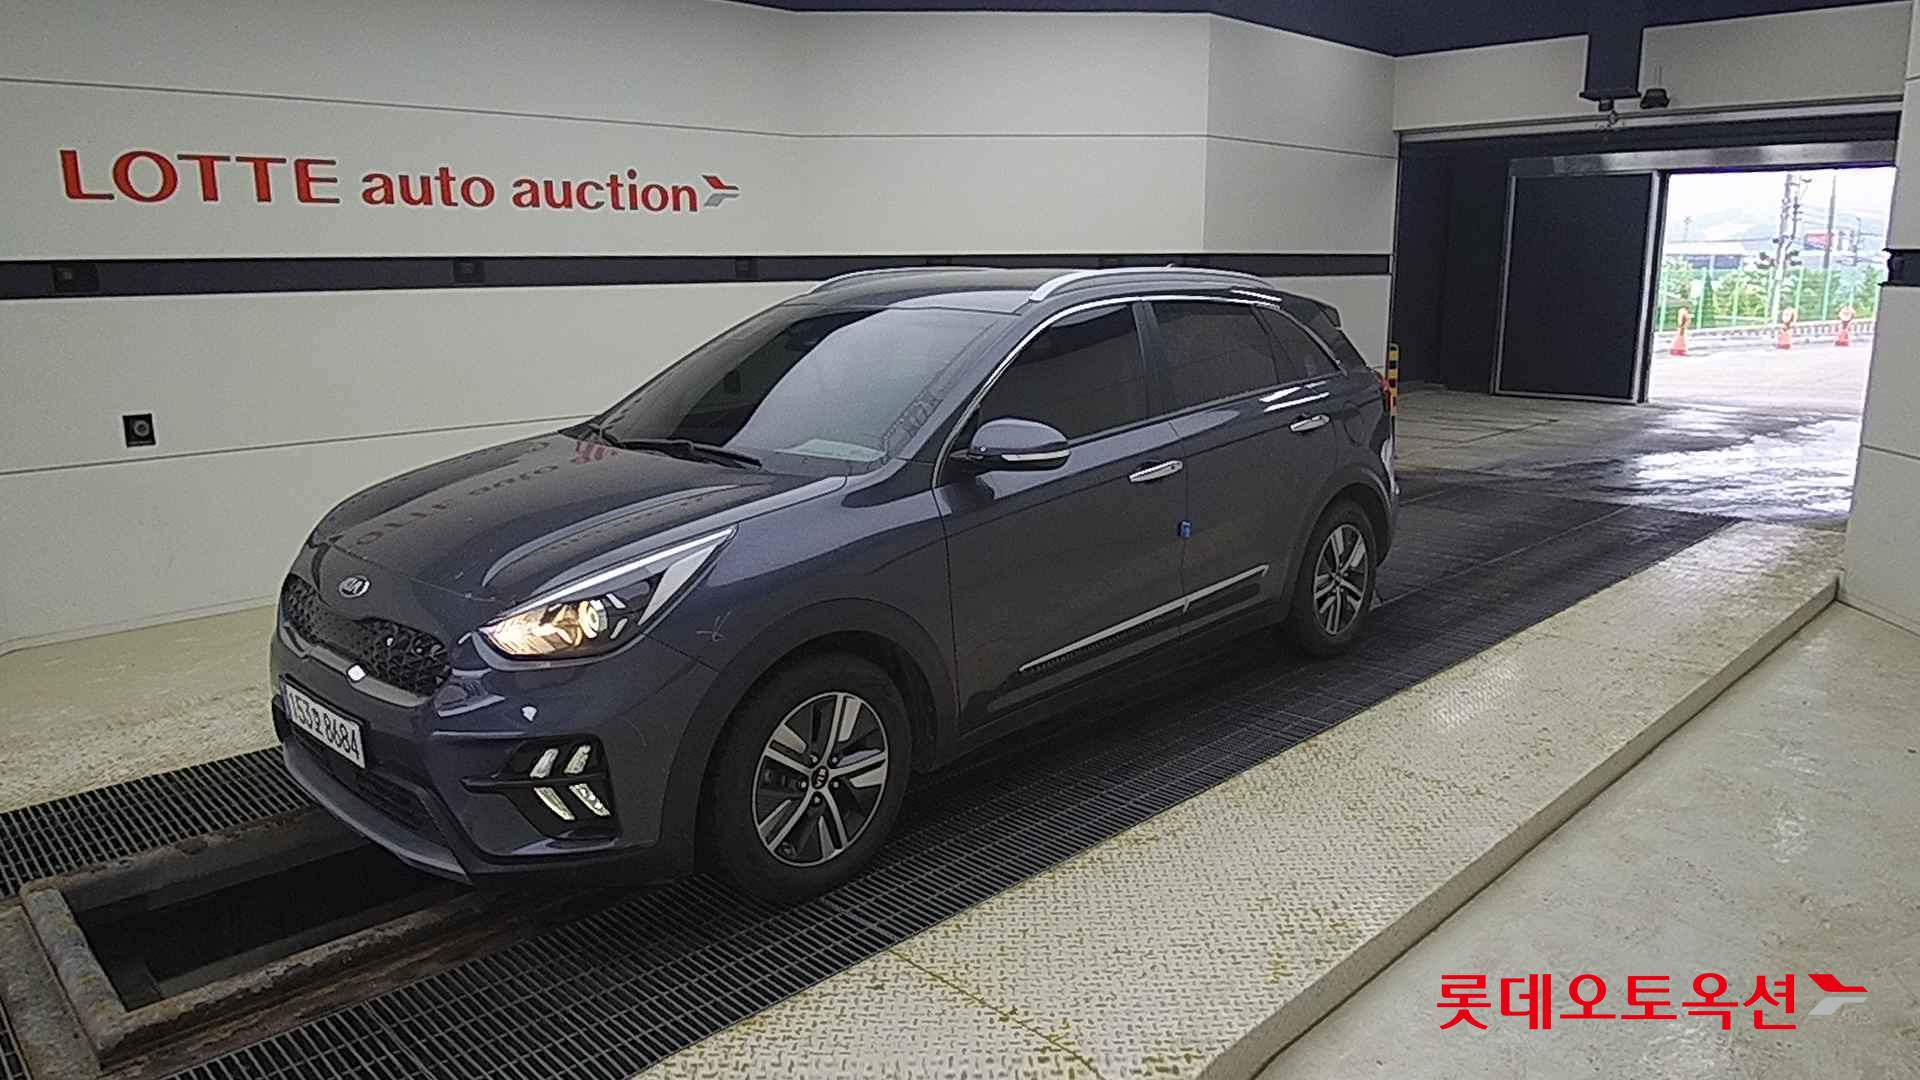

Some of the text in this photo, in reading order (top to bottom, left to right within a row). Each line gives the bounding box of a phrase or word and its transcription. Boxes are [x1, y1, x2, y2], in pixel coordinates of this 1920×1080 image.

[59, 149, 700, 213] LOTTE auto auction
